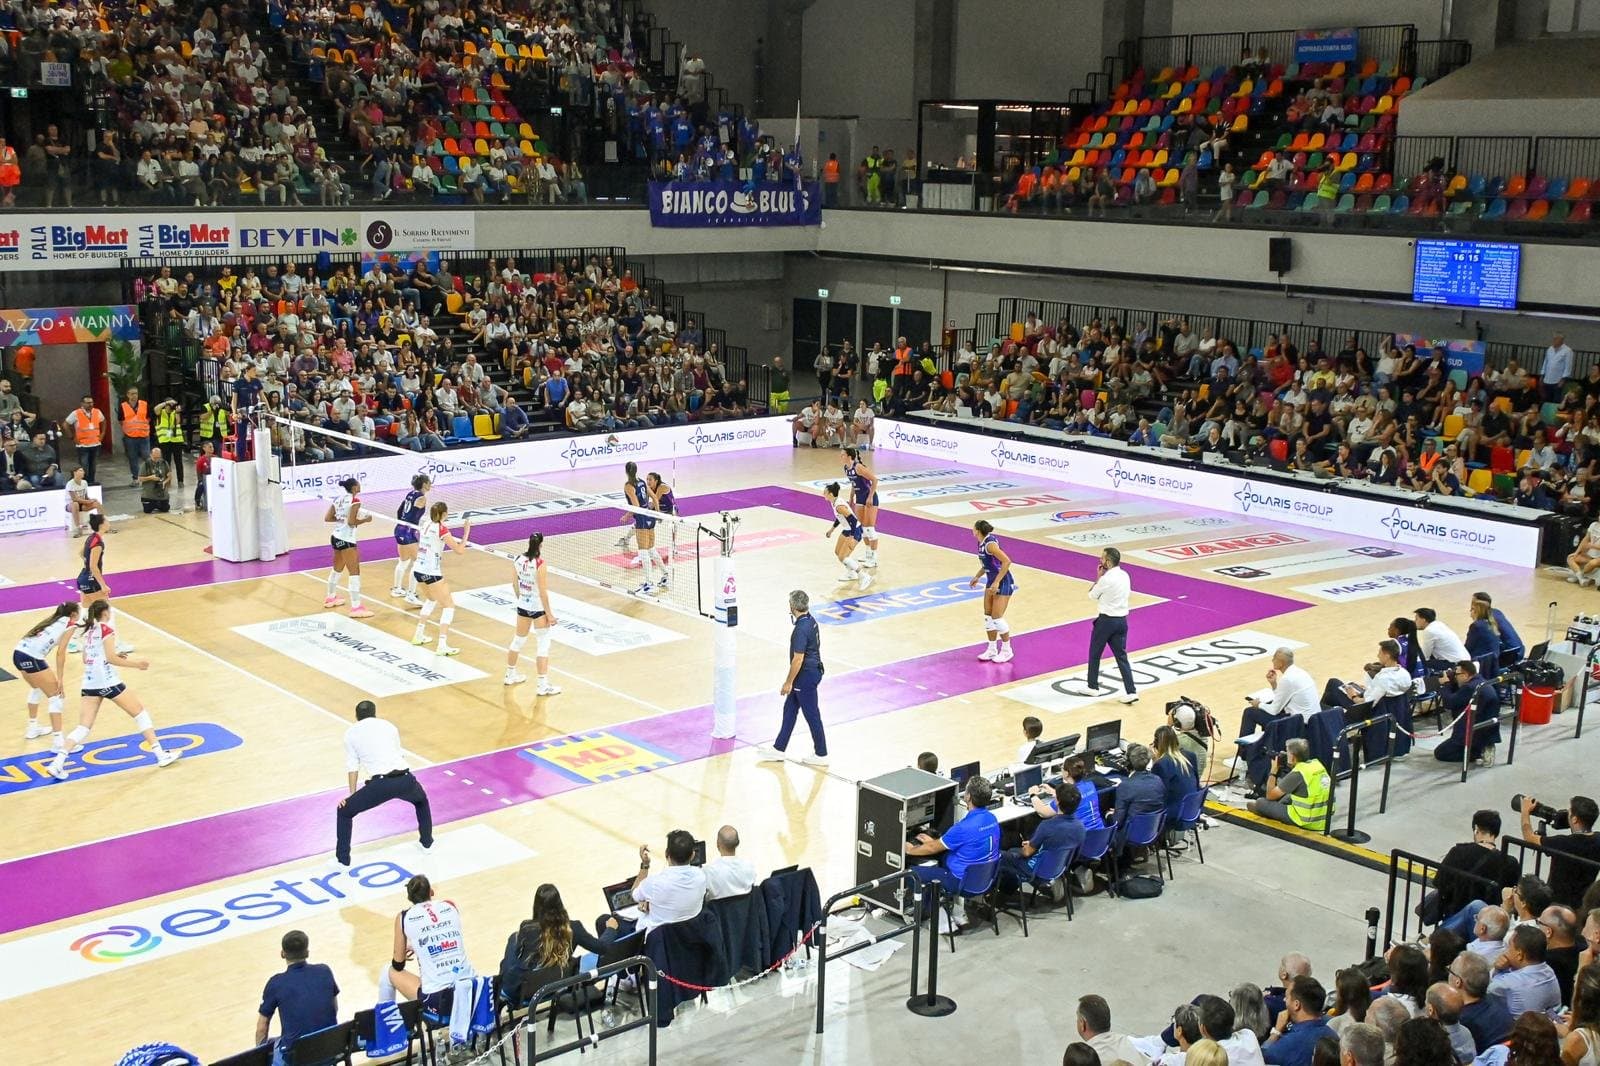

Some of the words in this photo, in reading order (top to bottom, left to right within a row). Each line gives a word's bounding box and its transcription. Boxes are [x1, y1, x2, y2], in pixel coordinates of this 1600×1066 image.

[662, 190, 728, 214] BIANCO
[31, 226, 47, 260] PALA
[51, 225, 129, 250] BigMat
[138, 224, 154, 256] PALA
[158, 223, 230, 248] BigMat
[239, 227, 339, 248] BEYFIN
[194, 248, 230, 256] BUILDERS
[1454, 253, 1465, 261] 16
[1468, 254, 1479, 262] 15
[0, 317, 54, 333] AZZO
[70, 313, 135, 329] WANNY
[697, 431, 735, 444] POLARIS
[736, 428, 766, 440] GROUP
[895, 432, 929, 445] POLARIS
[930, 437, 959, 449] GROUP
[570, 445, 613, 459] POLARIS
[616, 441, 649, 453] GROUP
[999, 449, 1037, 464] POLARIS
[1038, 456, 1070, 469] GROUP
[479, 456, 516, 469] GROUP
[1114, 469, 1156, 485] POLARIS
[1158, 477, 1193, 491] GROUP
[1244, 491, 1291, 509] POLARIS
[1293, 501, 1334, 516] GROUP
[1392, 518, 1447, 537] POLARIS
[1450, 528, 1496, 545] GROUP
[1168, 533, 1297, 557] VANGI
[1322, 580, 1388, 596] MASE
[322, 630, 378, 654] SAVINO
[369, 651, 402, 665] DEL
[398, 662, 446, 682] BENE
[1050, 638, 1268, 698] GUESS
[556, 744, 636, 768] MD
[160, 860, 415, 938] estra
